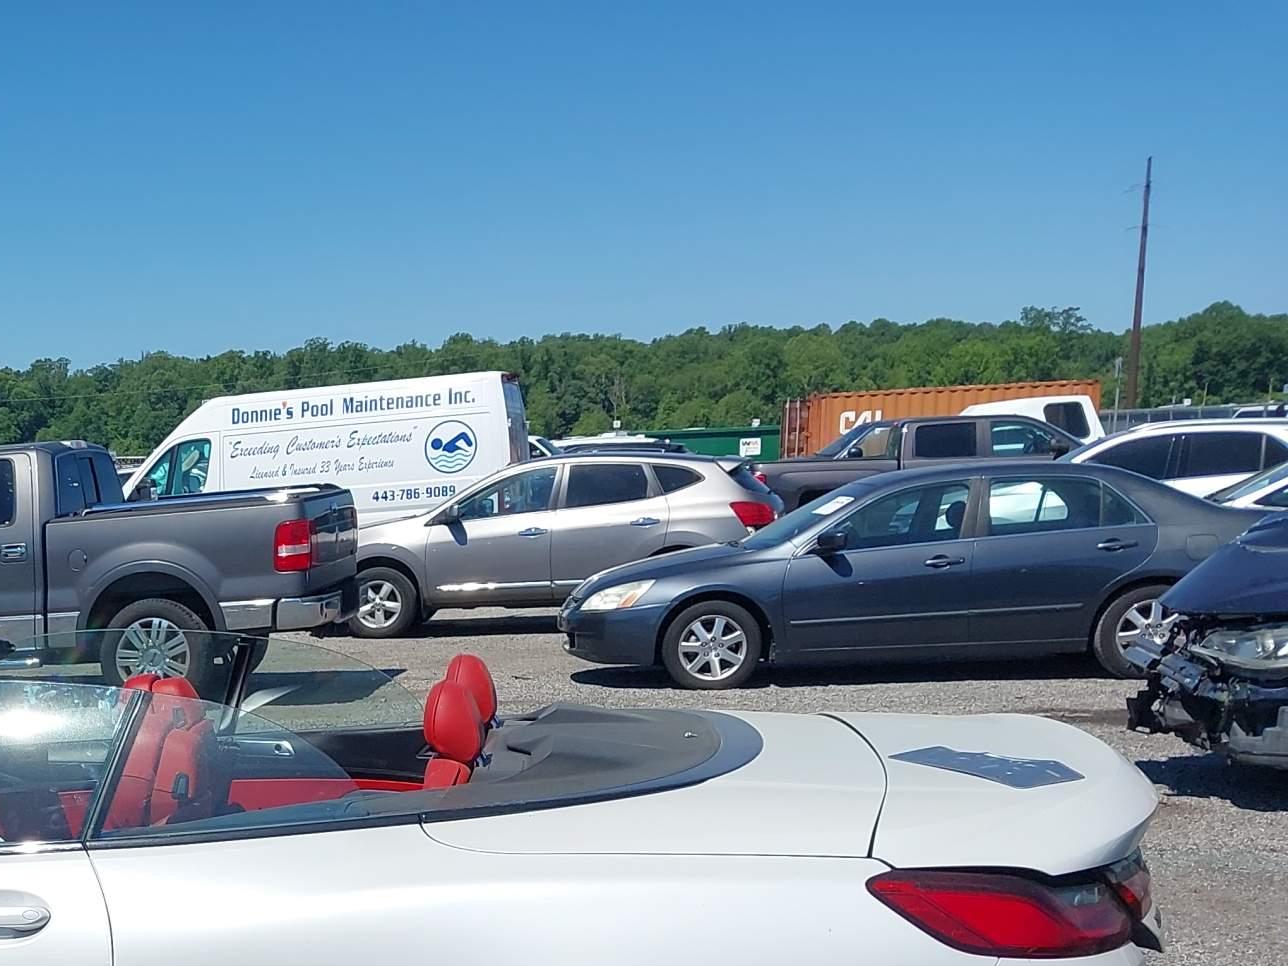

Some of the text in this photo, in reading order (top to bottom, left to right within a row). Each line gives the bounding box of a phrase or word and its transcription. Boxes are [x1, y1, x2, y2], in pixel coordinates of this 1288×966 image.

[231, 387, 475, 425] Donnie's Pool Maintenance Inc.
[286, 435, 342, 455] Customer's
[249, 456, 394, 479] Licensed & Insured 33 Years Experience
[372, 485, 456, 502] 443-786-9089
